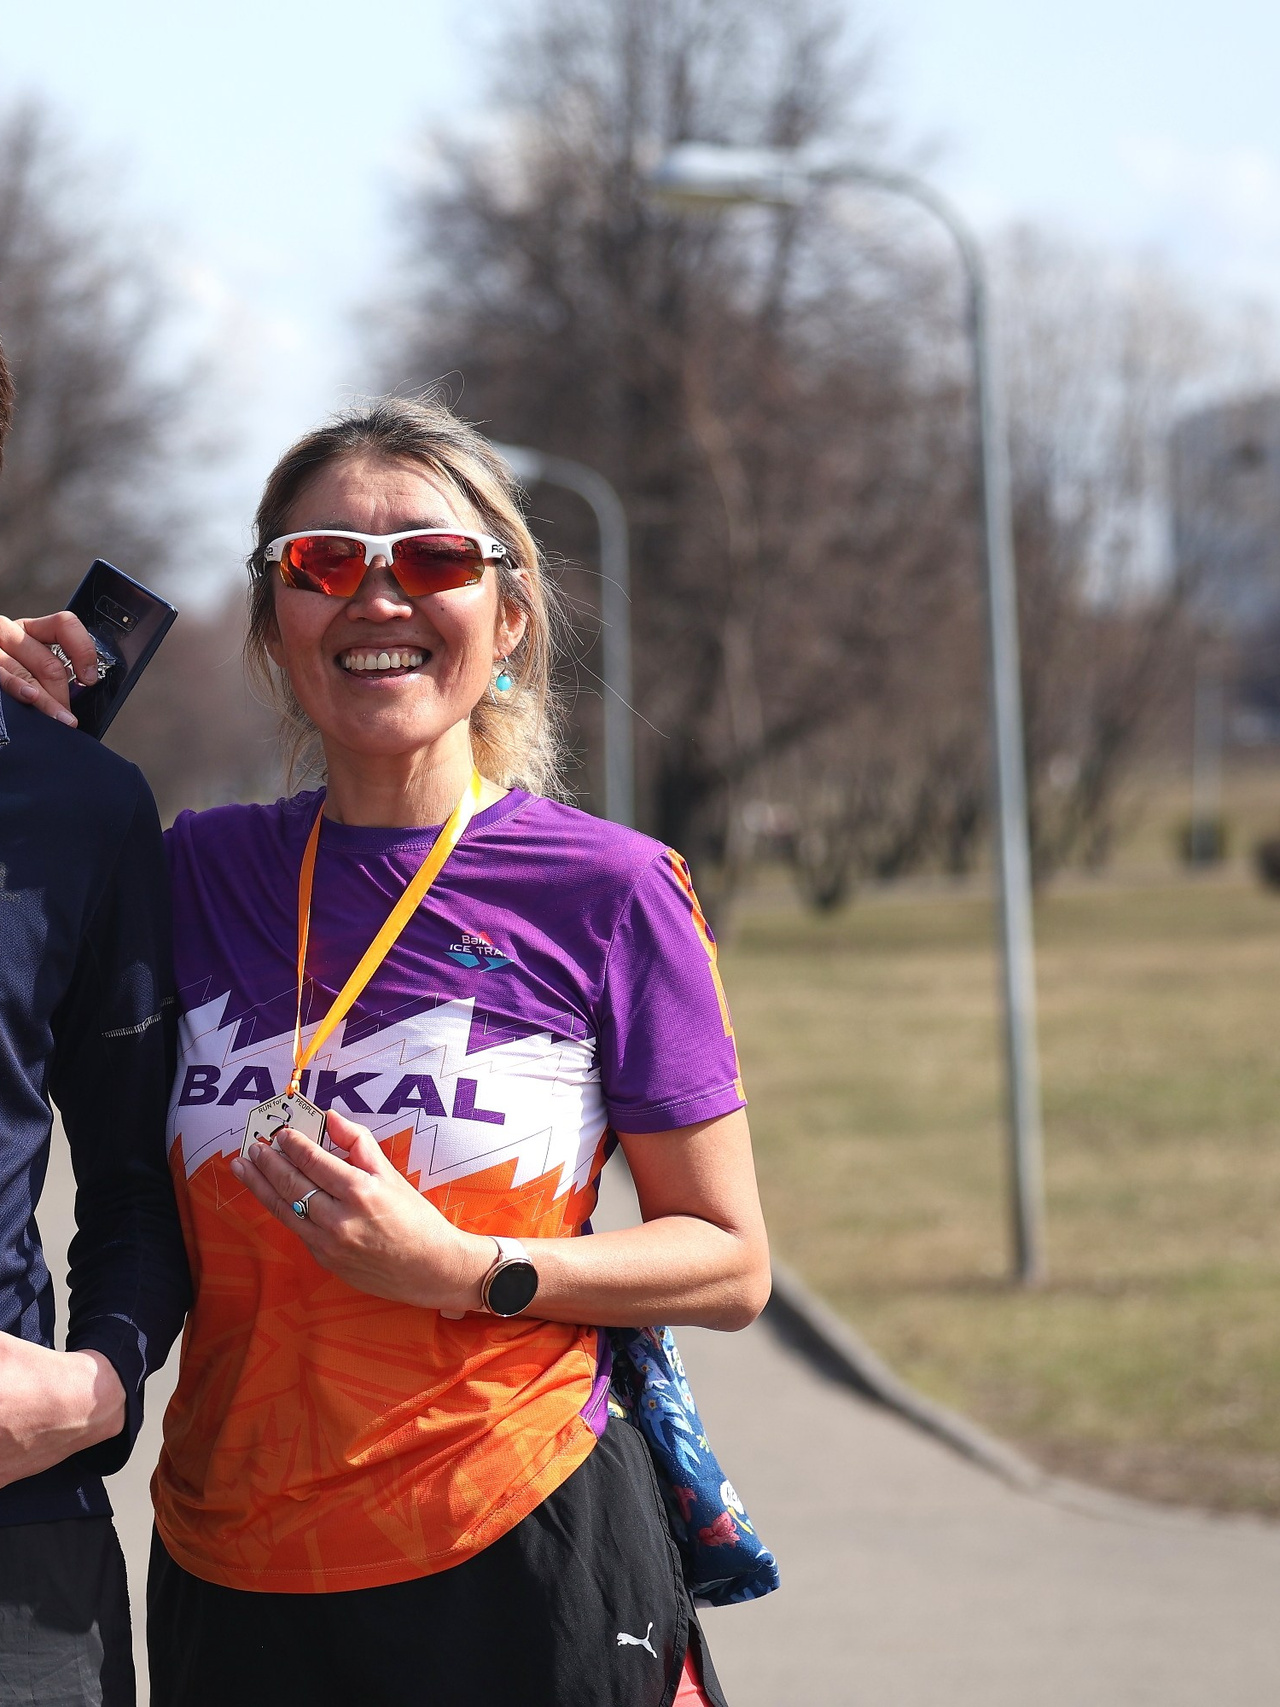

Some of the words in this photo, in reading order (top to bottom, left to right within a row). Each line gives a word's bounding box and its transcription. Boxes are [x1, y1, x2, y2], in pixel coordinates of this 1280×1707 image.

[450, 944, 472, 953] ICE
[476, 946, 507, 957] TRA
[258, 1103, 272, 1113] RUN
[295, 1098, 316, 1116] PEOPLE
